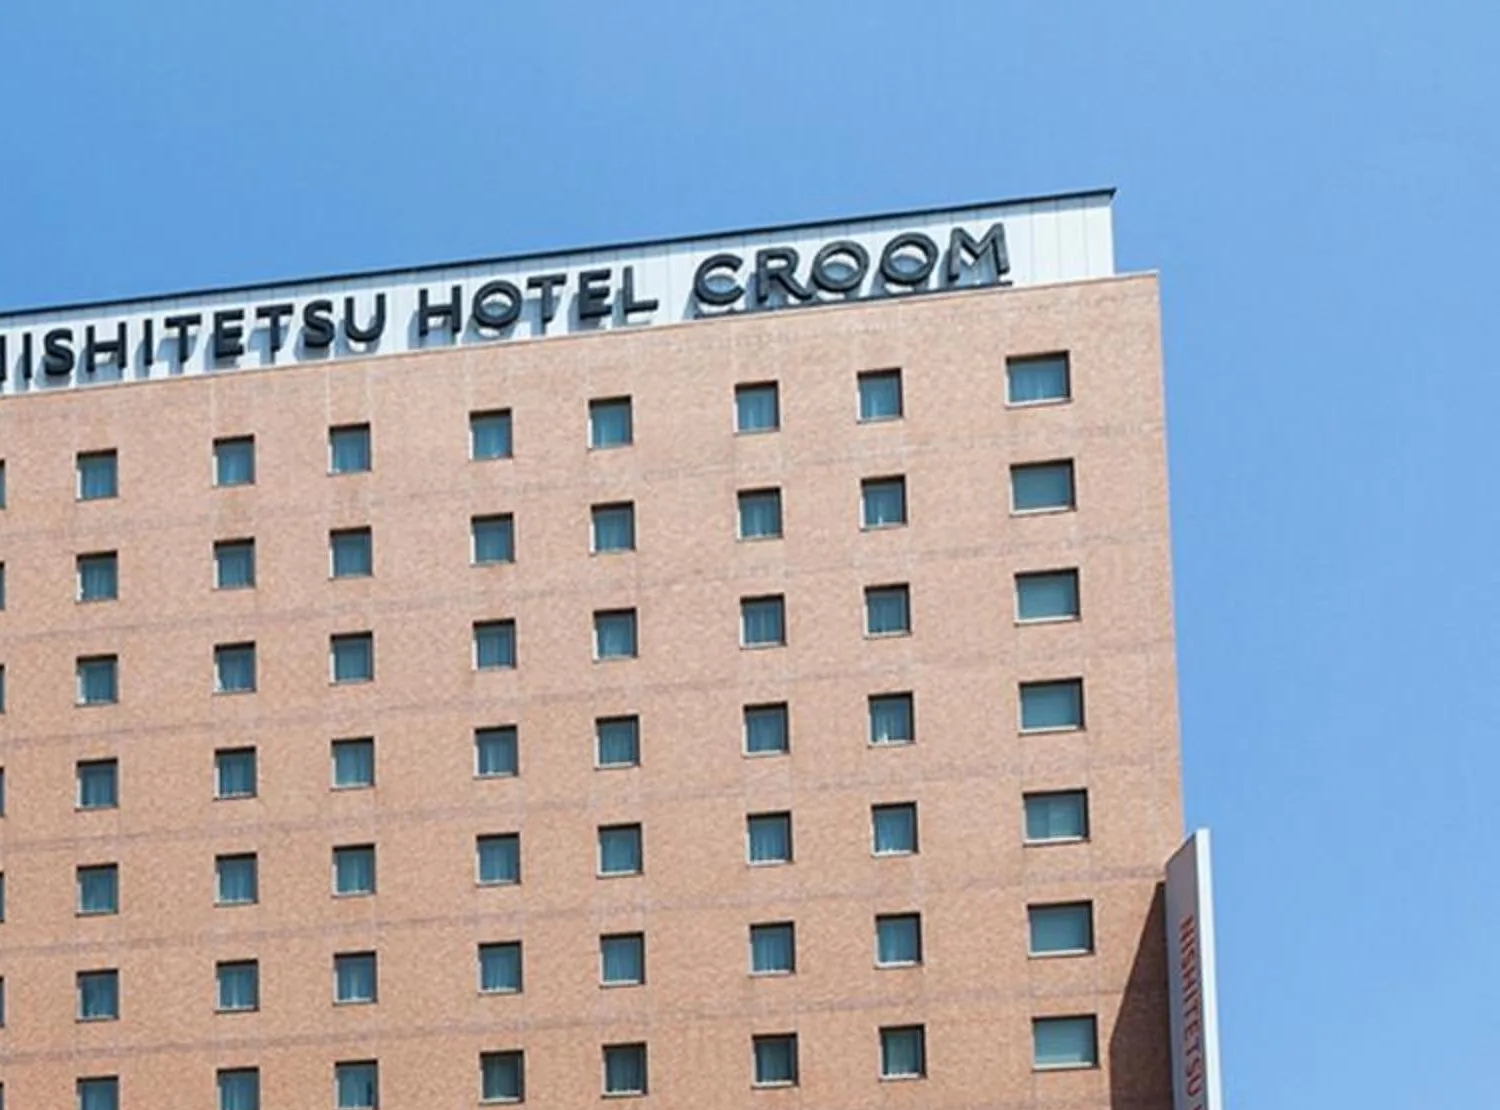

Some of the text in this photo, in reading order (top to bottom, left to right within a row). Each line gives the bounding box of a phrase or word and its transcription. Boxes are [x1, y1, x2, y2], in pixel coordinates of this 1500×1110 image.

[419, 265, 658, 337] HOTEL
[696, 222, 1012, 305] CROOM
[1180, 915, 1202, 1099] NISHITETSU
